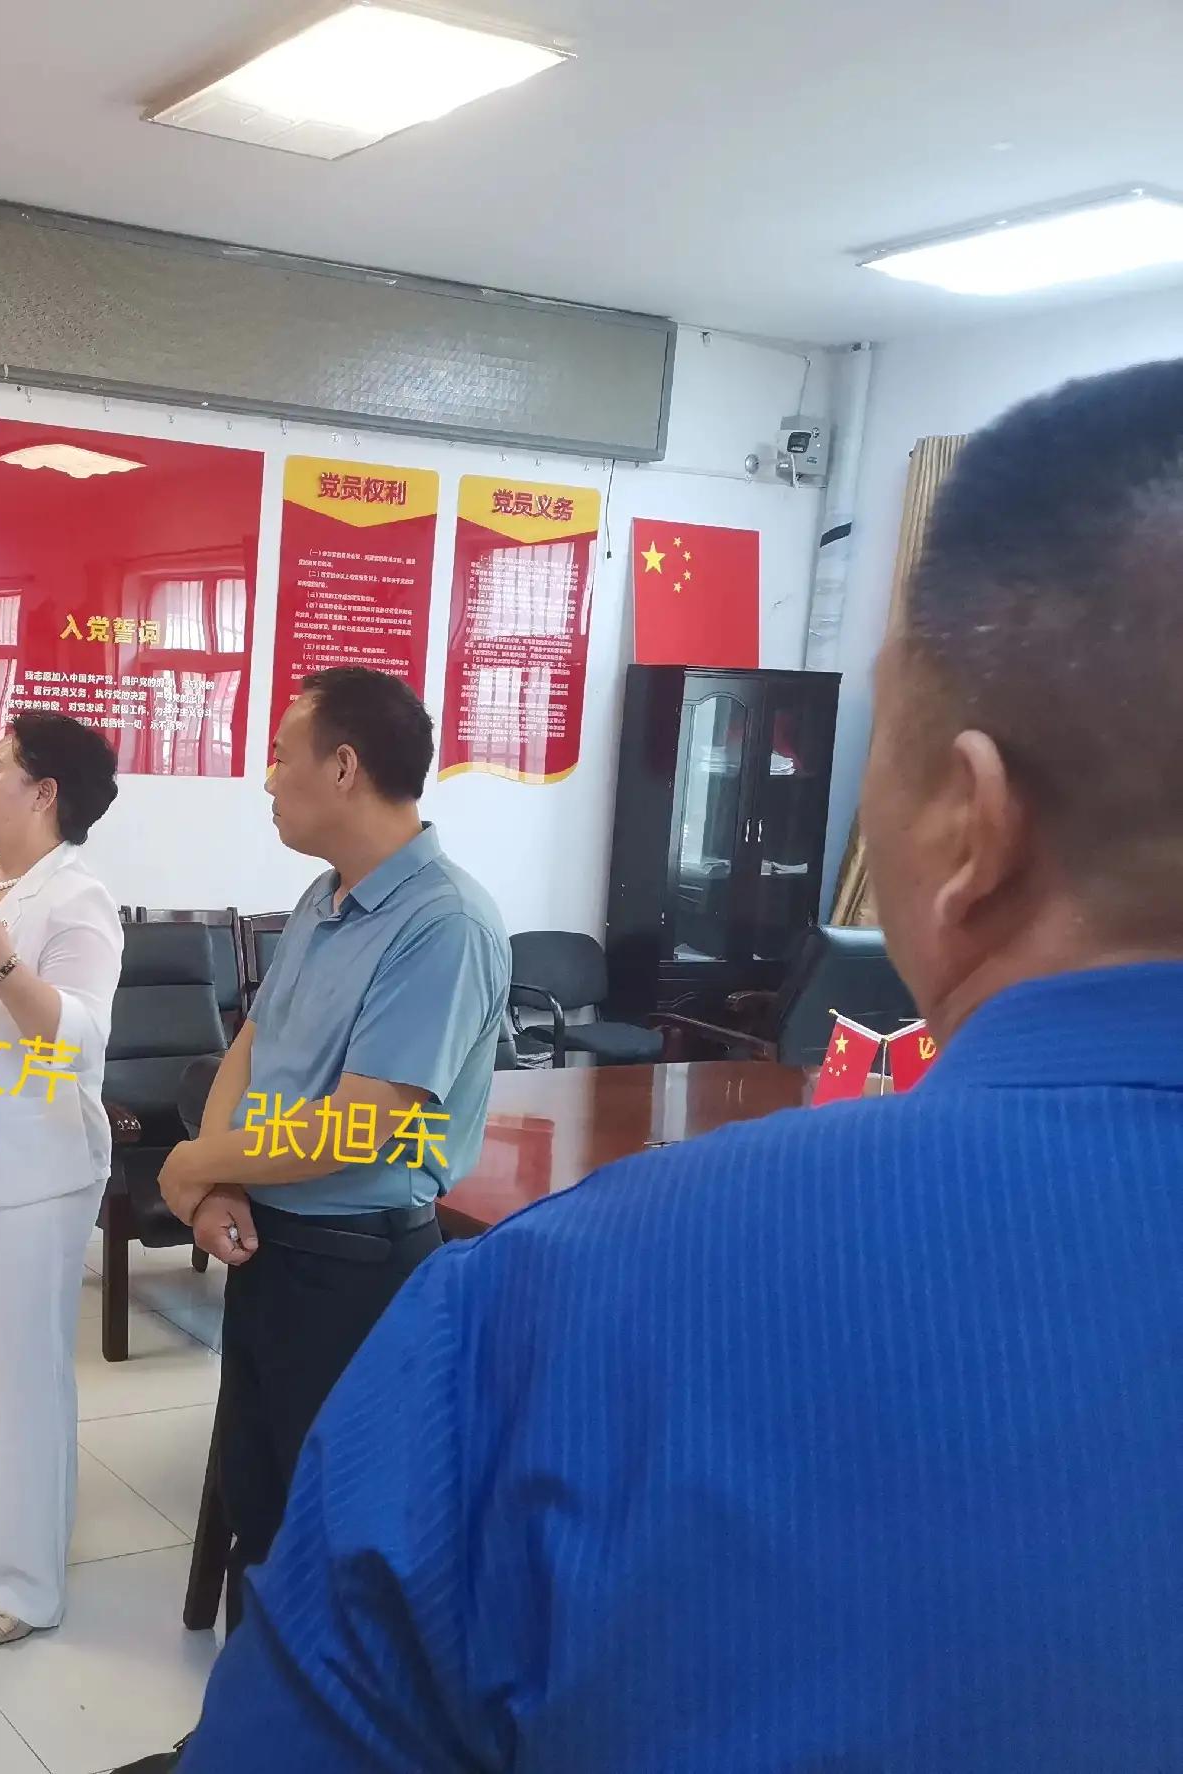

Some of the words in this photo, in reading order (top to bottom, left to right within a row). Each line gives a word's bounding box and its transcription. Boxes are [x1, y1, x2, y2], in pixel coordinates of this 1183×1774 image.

[317, 472, 407, 506] 党员权利
[491, 488, 574, 522] 党员义务
[59, 613, 160, 645] 入党誓词
